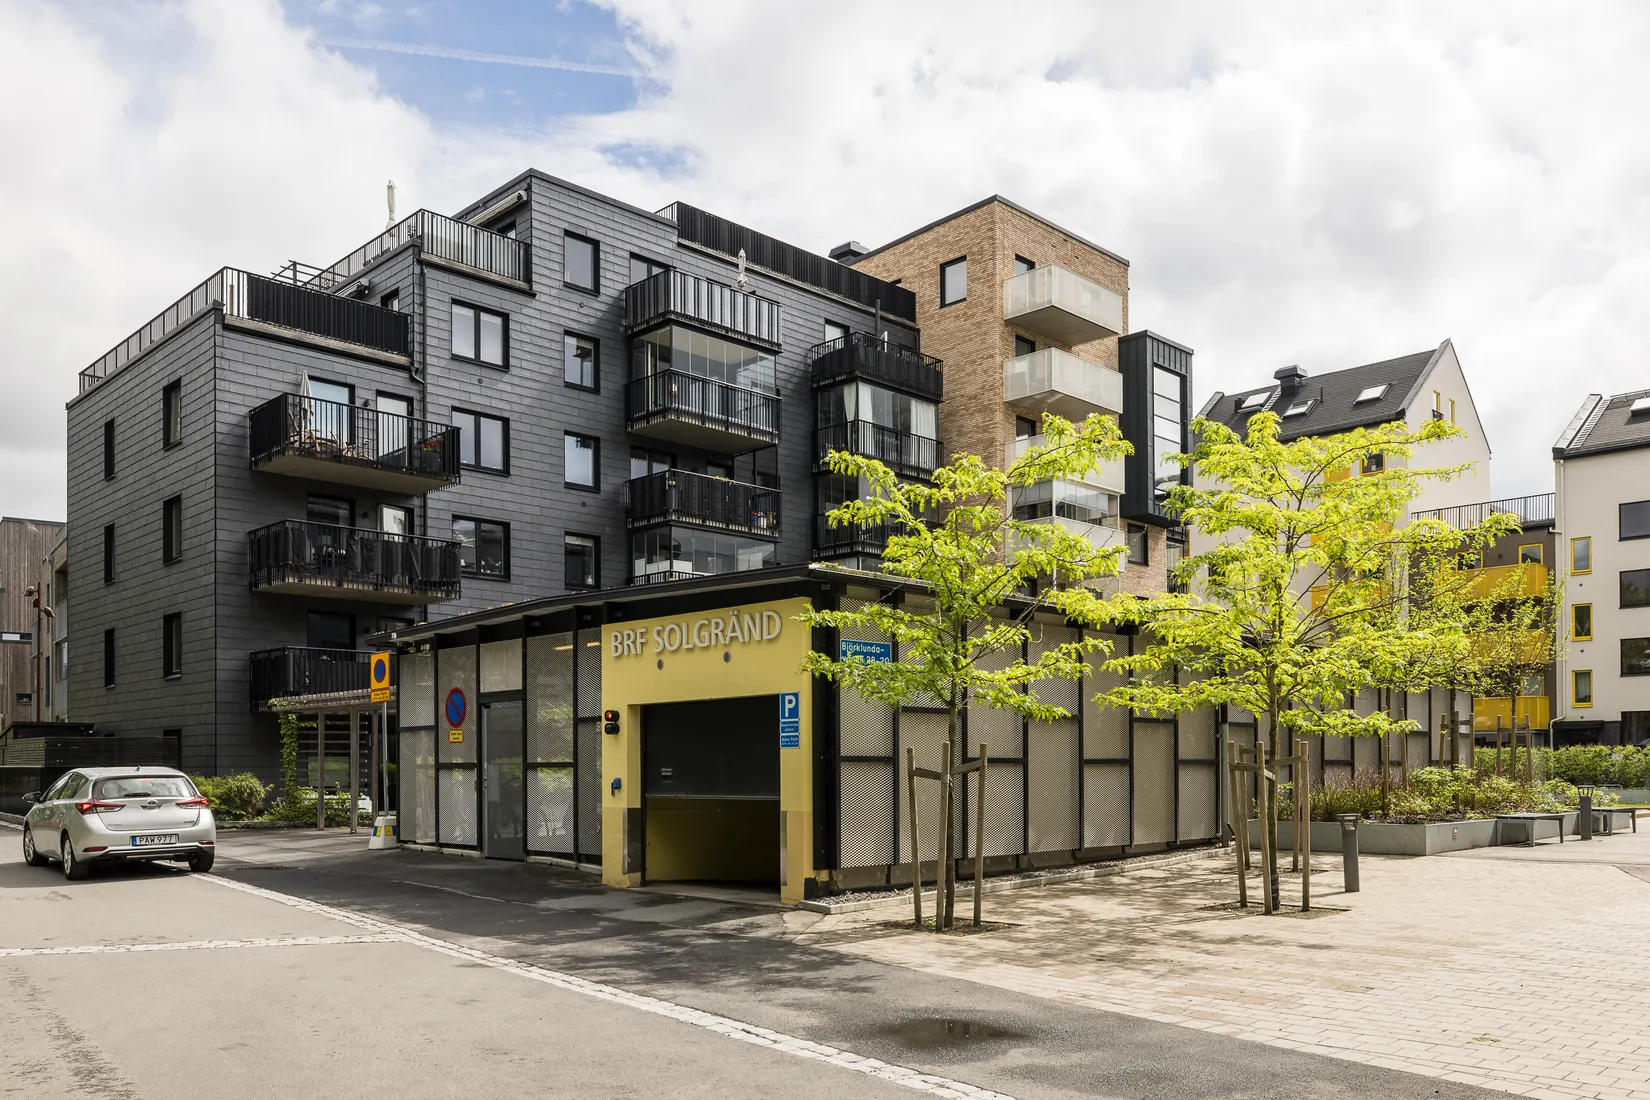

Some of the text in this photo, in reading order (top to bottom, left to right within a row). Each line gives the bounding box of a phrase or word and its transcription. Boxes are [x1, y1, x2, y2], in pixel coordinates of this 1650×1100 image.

[611, 610, 782, 657] BRF SOLGRÄND
[841, 641, 885, 654] Björklunda-
[785, 695, 796, 717] P
[139, 835, 173, 844] PAW 977
